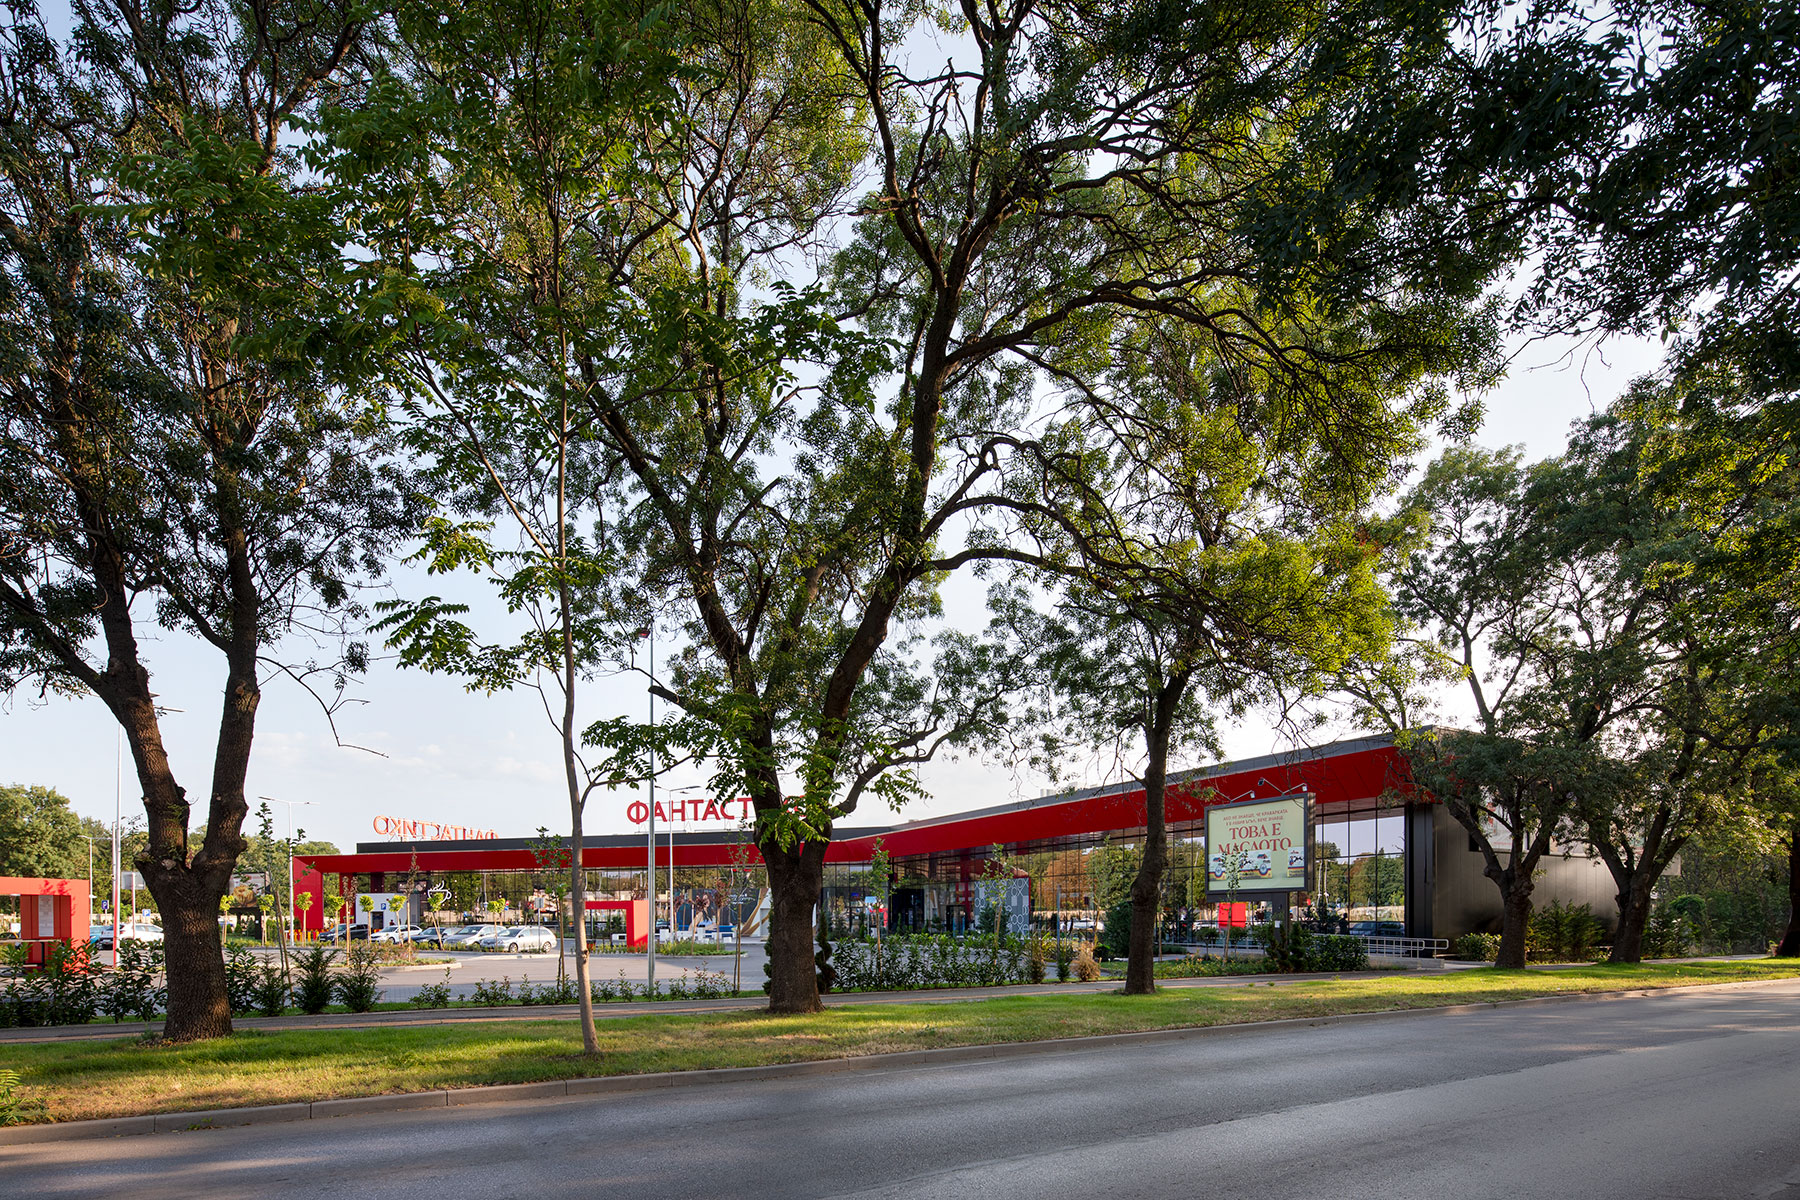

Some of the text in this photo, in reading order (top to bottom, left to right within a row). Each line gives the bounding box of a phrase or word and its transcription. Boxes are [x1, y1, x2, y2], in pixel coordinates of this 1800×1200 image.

[626, 797, 806, 824] ФАНТАСТ
[1229, 822, 1281, 840] ТОВА Е
[1218, 837, 1291, 855] МАСЛОТО
